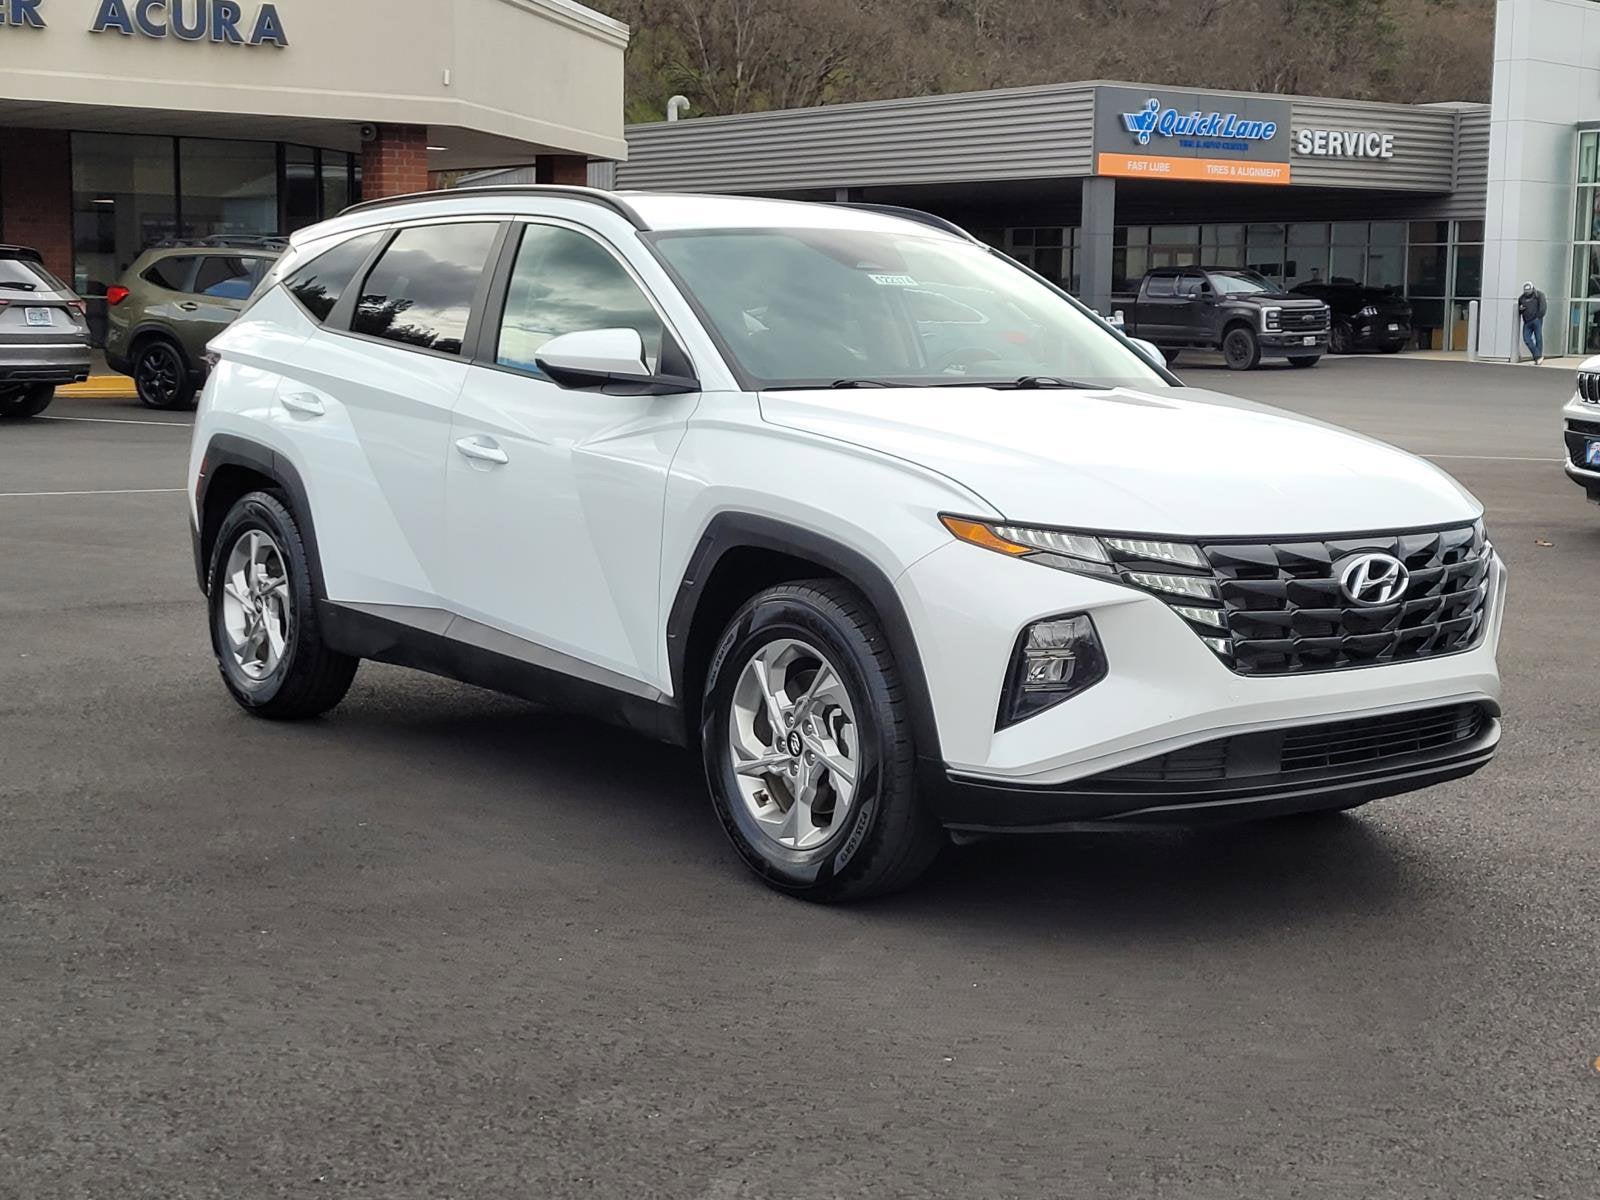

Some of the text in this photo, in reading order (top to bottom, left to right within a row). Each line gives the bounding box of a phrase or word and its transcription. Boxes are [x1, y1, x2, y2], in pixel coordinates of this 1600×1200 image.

[89, 0, 289, 47] ACURA
[1159, 108, 1277, 140] Quick Lane
[1297, 128, 1394, 158] SERVICE
[1127, 160, 1147, 171] FAST
[1149, 162, 1171, 172] LUBE
[1207, 164, 1230, 175] TIRES
[1237, 167, 1282, 177] ALIGNMENT
